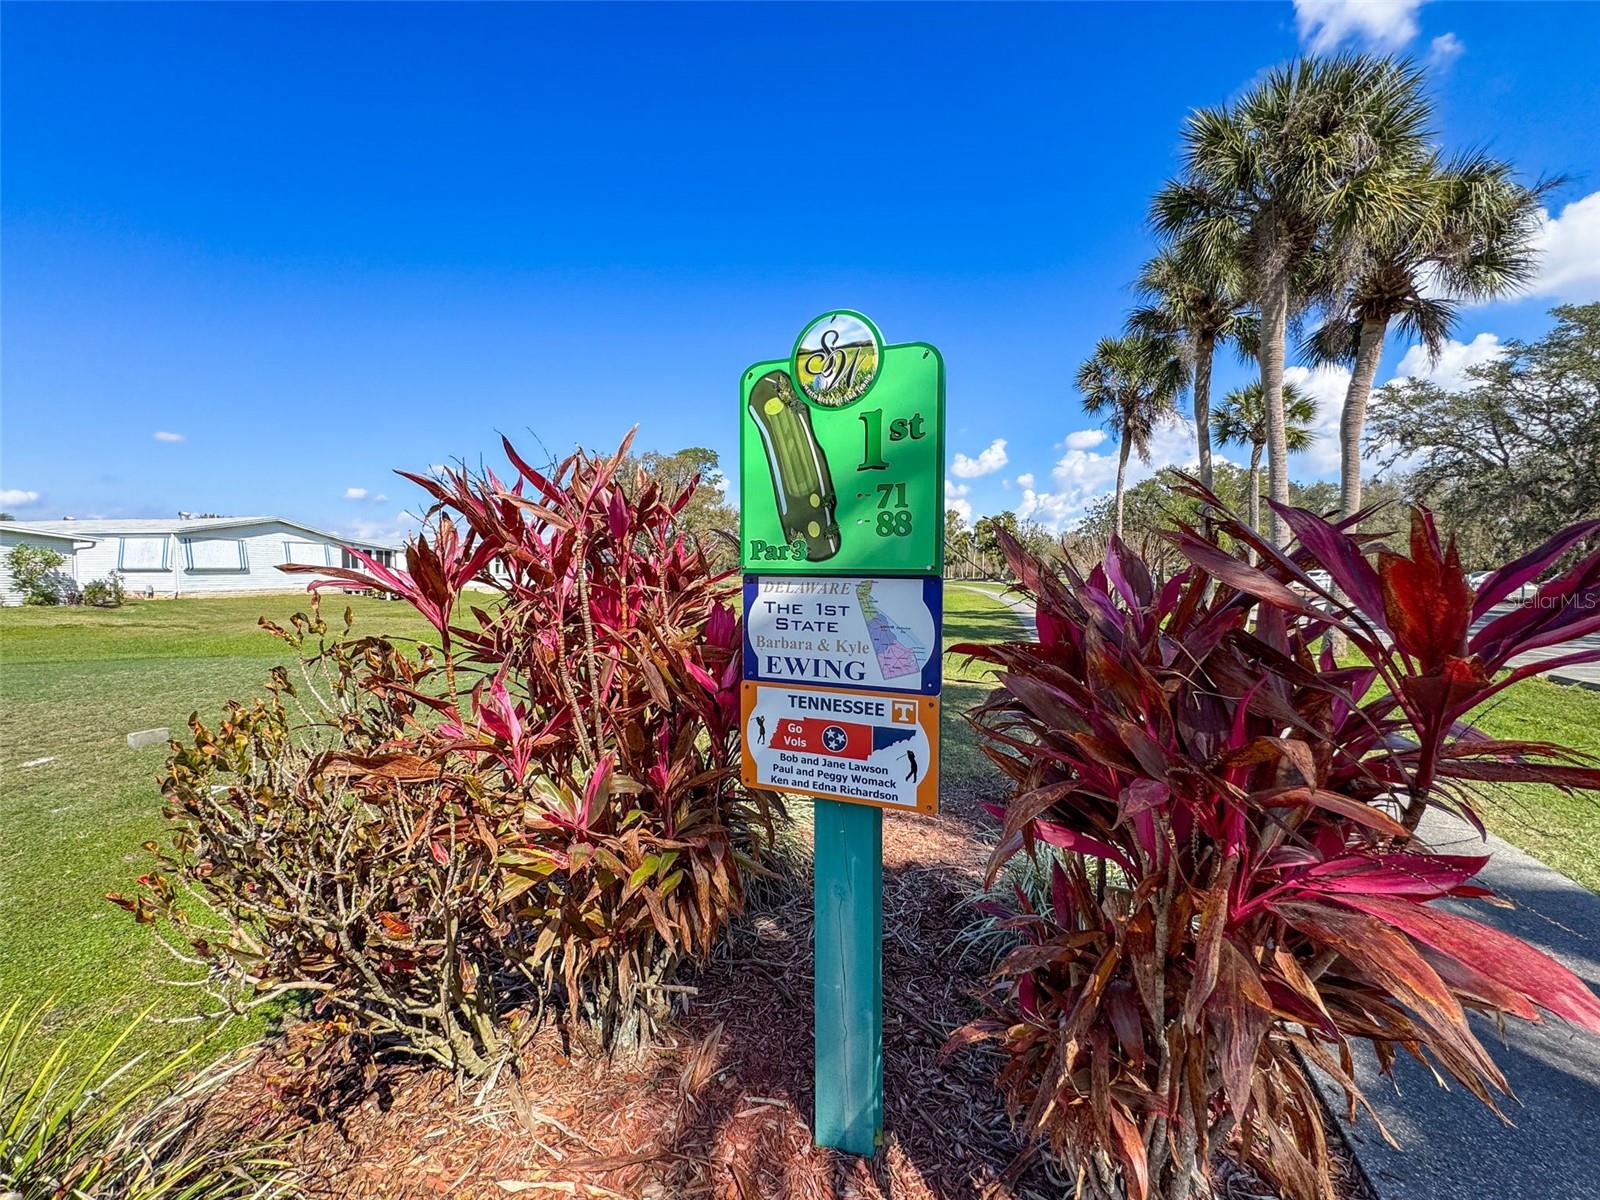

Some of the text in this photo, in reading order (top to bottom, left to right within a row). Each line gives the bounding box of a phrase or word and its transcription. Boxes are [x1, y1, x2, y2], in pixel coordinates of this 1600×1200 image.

[876, 483, 909, 509] 71
[876, 511, 912, 537] 88
[763, 580, 851, 595] DELAWARE
[756, 635, 870, 656] Barbara & Kyle
[766, 655, 866, 681] EWING
[788, 694, 885, 717] TENNESSEE
[894, 703, 914, 721] T
[787, 722, 803, 734] Go
[783, 735, 807, 748] Vols
[780, 753, 889, 775] Bob and Jane Lawson
[772, 763, 896, 789] Paul and Peggy Womack
[770, 775, 899, 801] Ken and Edna Richardson
